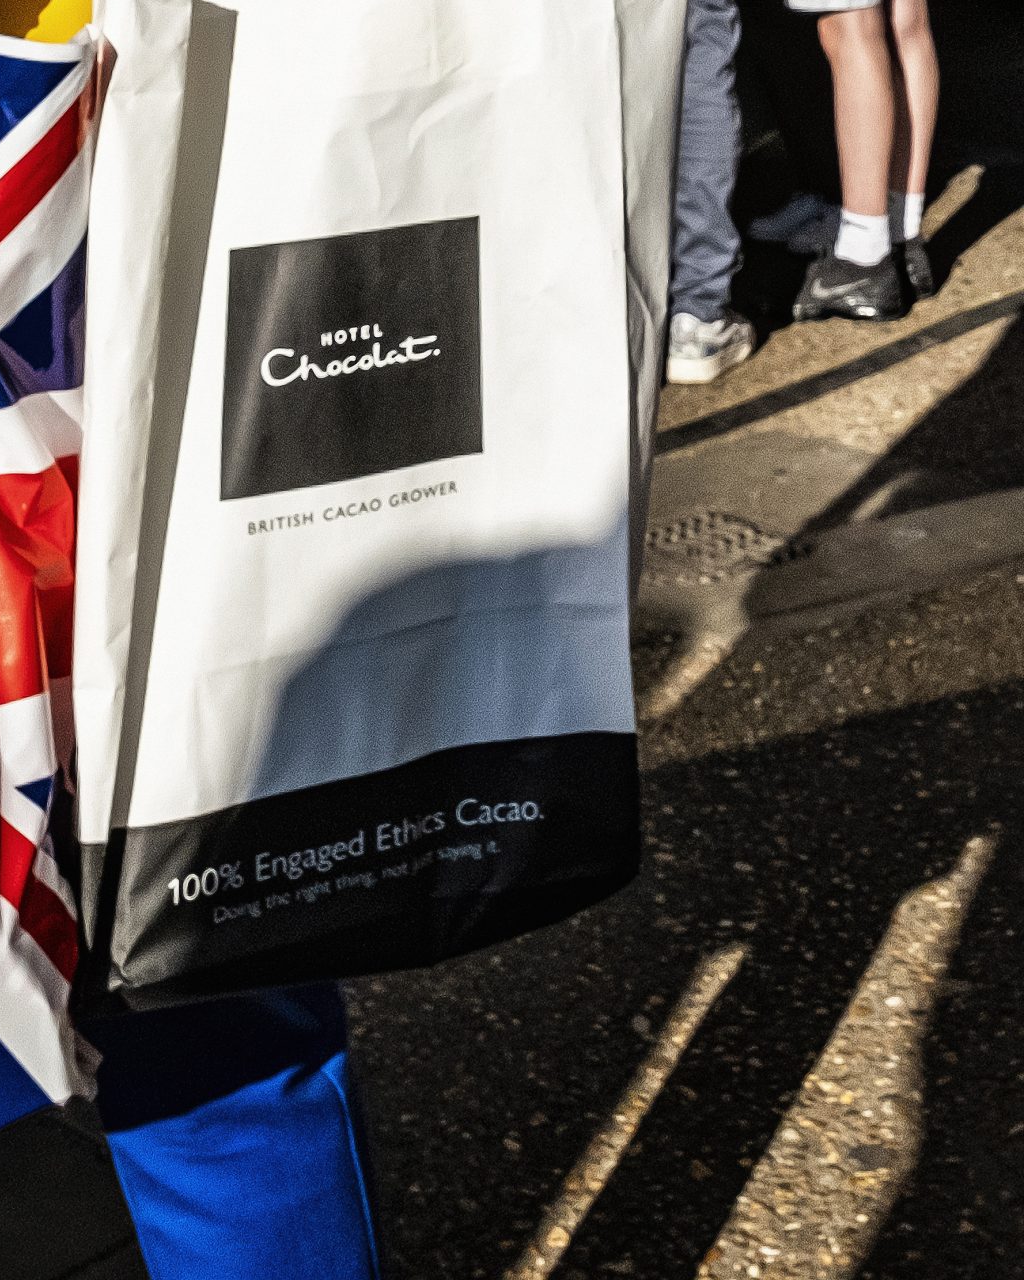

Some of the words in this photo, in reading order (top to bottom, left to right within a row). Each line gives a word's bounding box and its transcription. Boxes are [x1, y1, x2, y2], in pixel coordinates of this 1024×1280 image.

[321, 323, 383, 346] HOTEL
[247, 511, 314, 536] BRITISH
[322, 498, 383, 522] CACAO
[388, 480, 458, 508] GROWER
[167, 860, 244, 906] 100%
[255, 831, 365, 880] Engaged
[376, 811, 445, 851] Ethics
[456, 798, 545, 827] Cacao.
[214, 901, 261, 924] Doing
[265, 892, 290, 909] the
[295, 880, 330, 903] right
